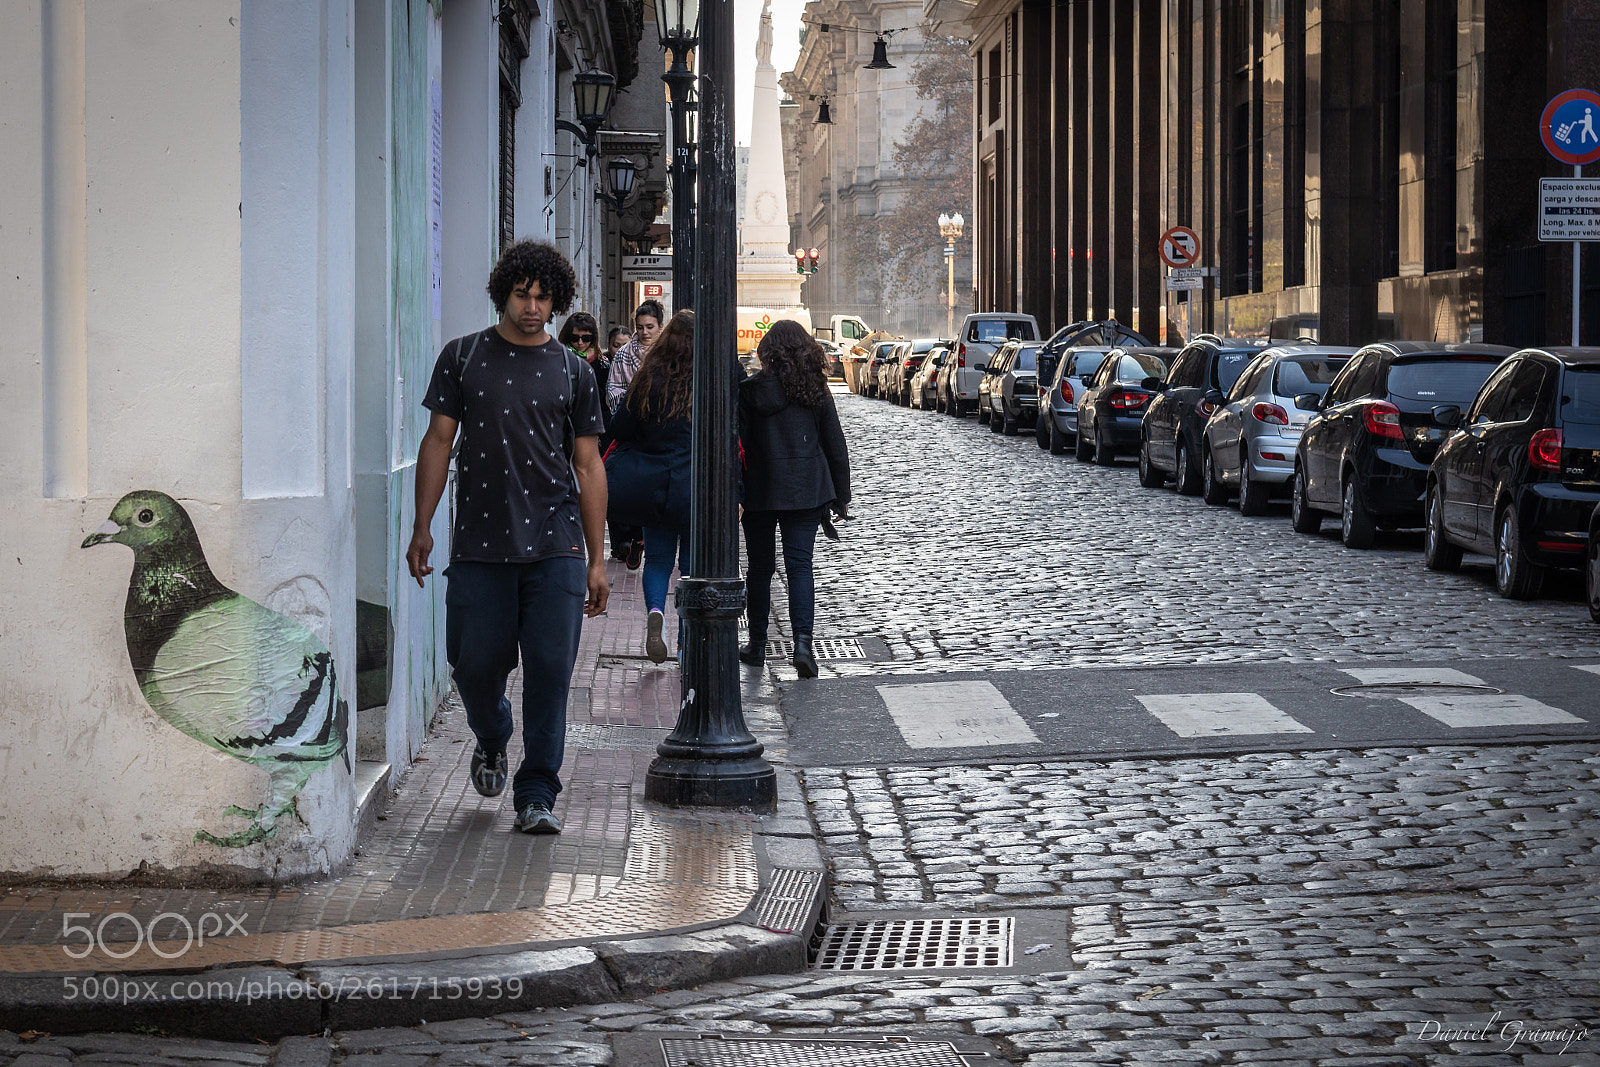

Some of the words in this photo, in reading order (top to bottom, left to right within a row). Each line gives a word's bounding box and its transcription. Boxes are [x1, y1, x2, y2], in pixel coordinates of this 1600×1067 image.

[1542, 183, 1574, 192] Espacio
[1543, 219, 1566, 227] Long.
[1565, 467, 1585, 475] FOX
